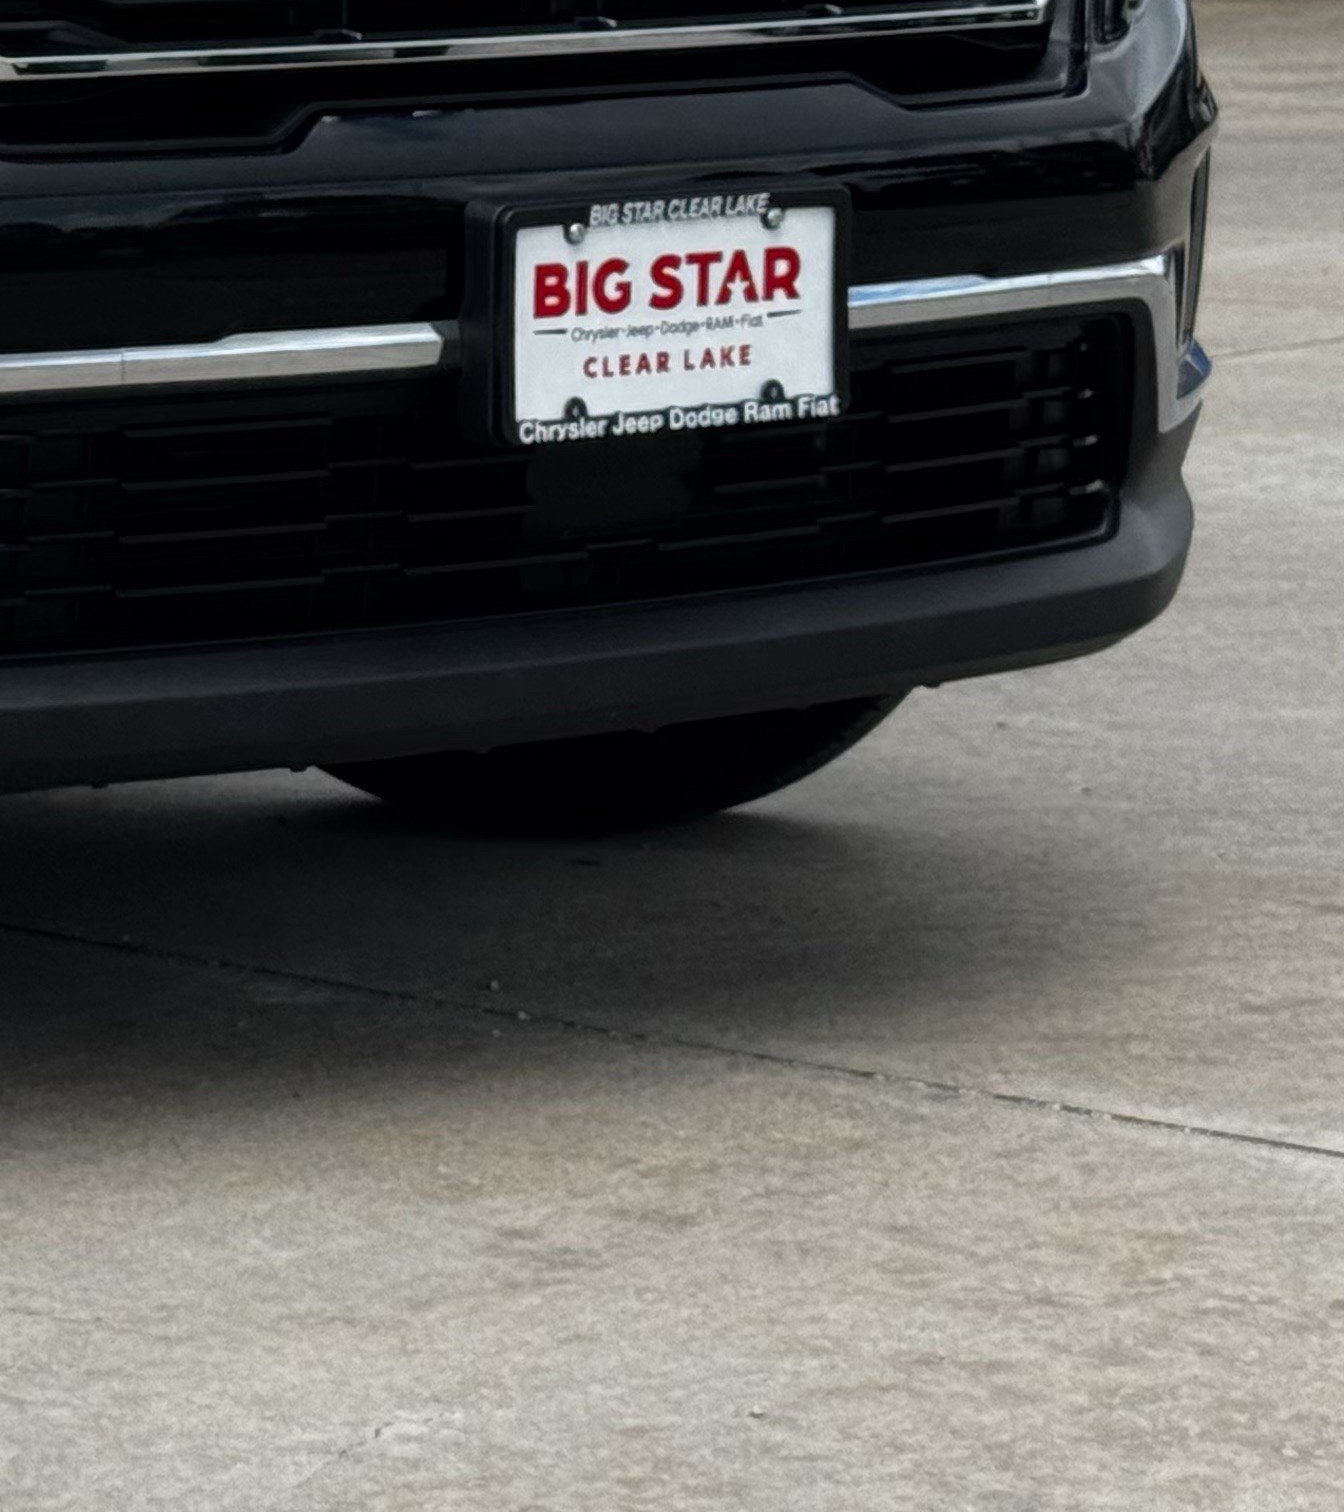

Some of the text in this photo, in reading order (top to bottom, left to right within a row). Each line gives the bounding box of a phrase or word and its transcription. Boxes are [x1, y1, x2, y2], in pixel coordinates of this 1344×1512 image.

[589, 192, 771, 227] BIG STAR CLEAR LAKE
[532, 246, 801, 320] BIG STAR
[582, 343, 752, 379] CLEAR LAKE
[518, 393, 841, 446] Chrysler Jeep Dodge Ram Fiat
